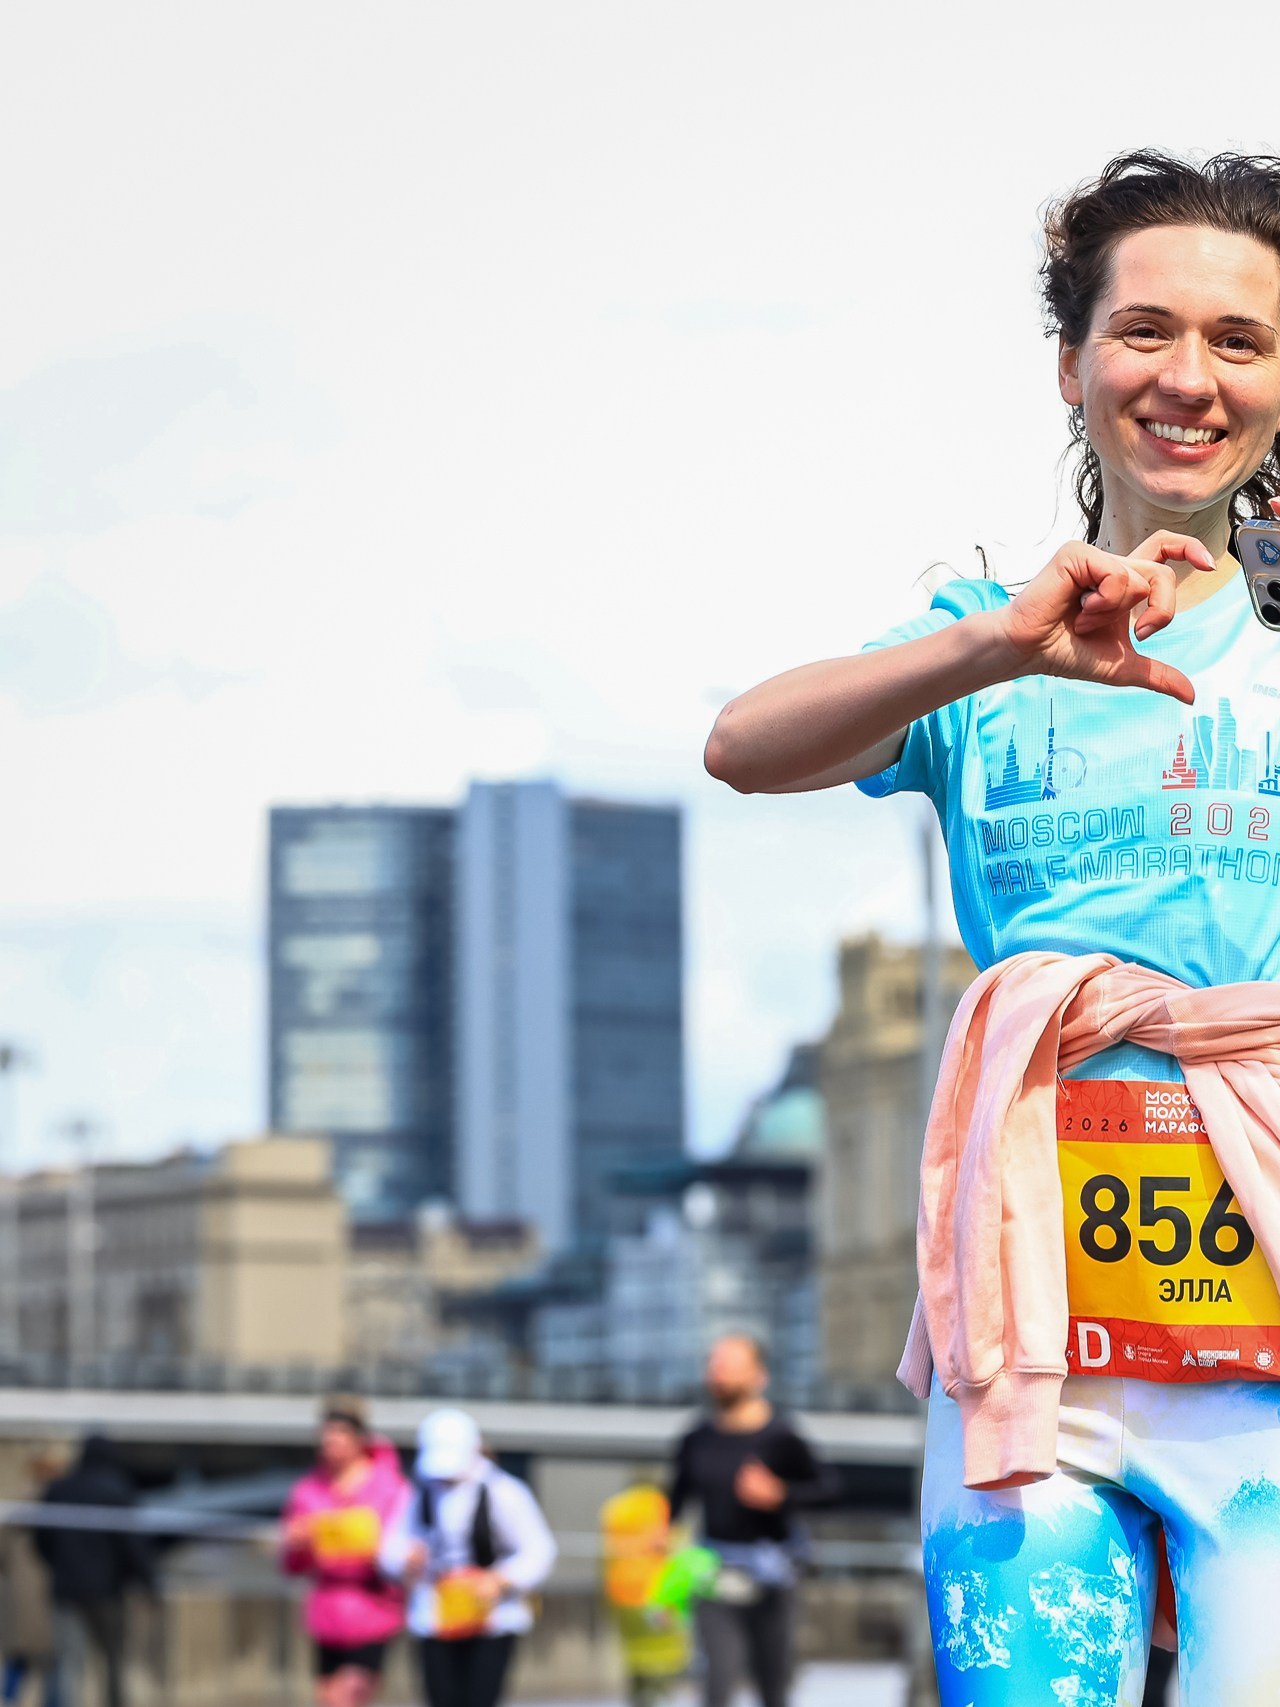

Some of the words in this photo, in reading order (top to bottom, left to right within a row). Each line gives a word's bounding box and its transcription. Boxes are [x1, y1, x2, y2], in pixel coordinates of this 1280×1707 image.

[982, 805, 1145, 855] MOSCOW
[986, 855, 1066, 897] HALF
[1064, 1117, 1129, 1133] 2026
[1145, 1106, 1189, 1119] ПОЛУ
[1158, 1278, 1233, 1303] ЭЛЛА
[1076, 1321, 1112, 1368] D
